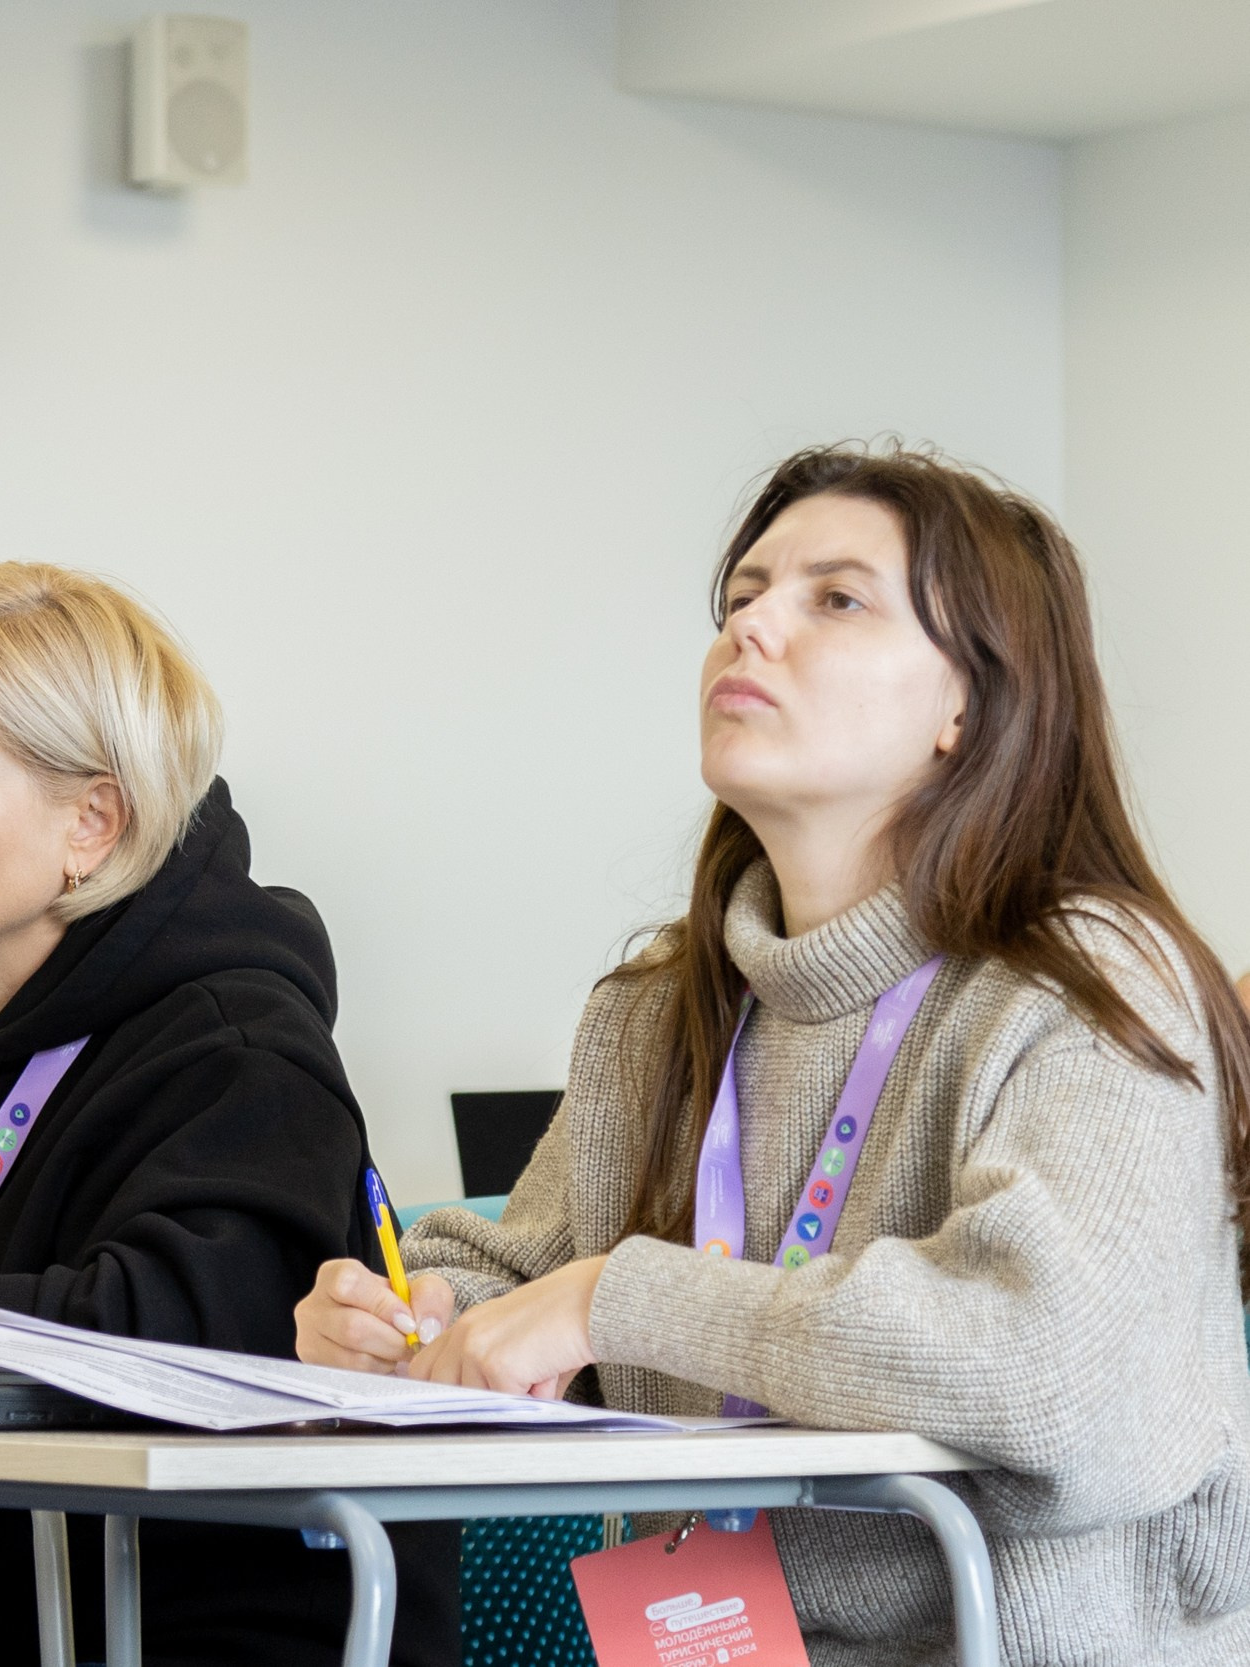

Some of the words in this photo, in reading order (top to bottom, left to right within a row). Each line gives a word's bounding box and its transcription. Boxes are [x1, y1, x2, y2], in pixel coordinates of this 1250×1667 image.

[670, 1601, 740, 1628] путешествие
[658, 1626, 753, 1663] ТУРИСТИЧЕСКИЙ
[670, 1656, 707, 1667] РУМ
[731, 1642, 758, 1658] 2024
